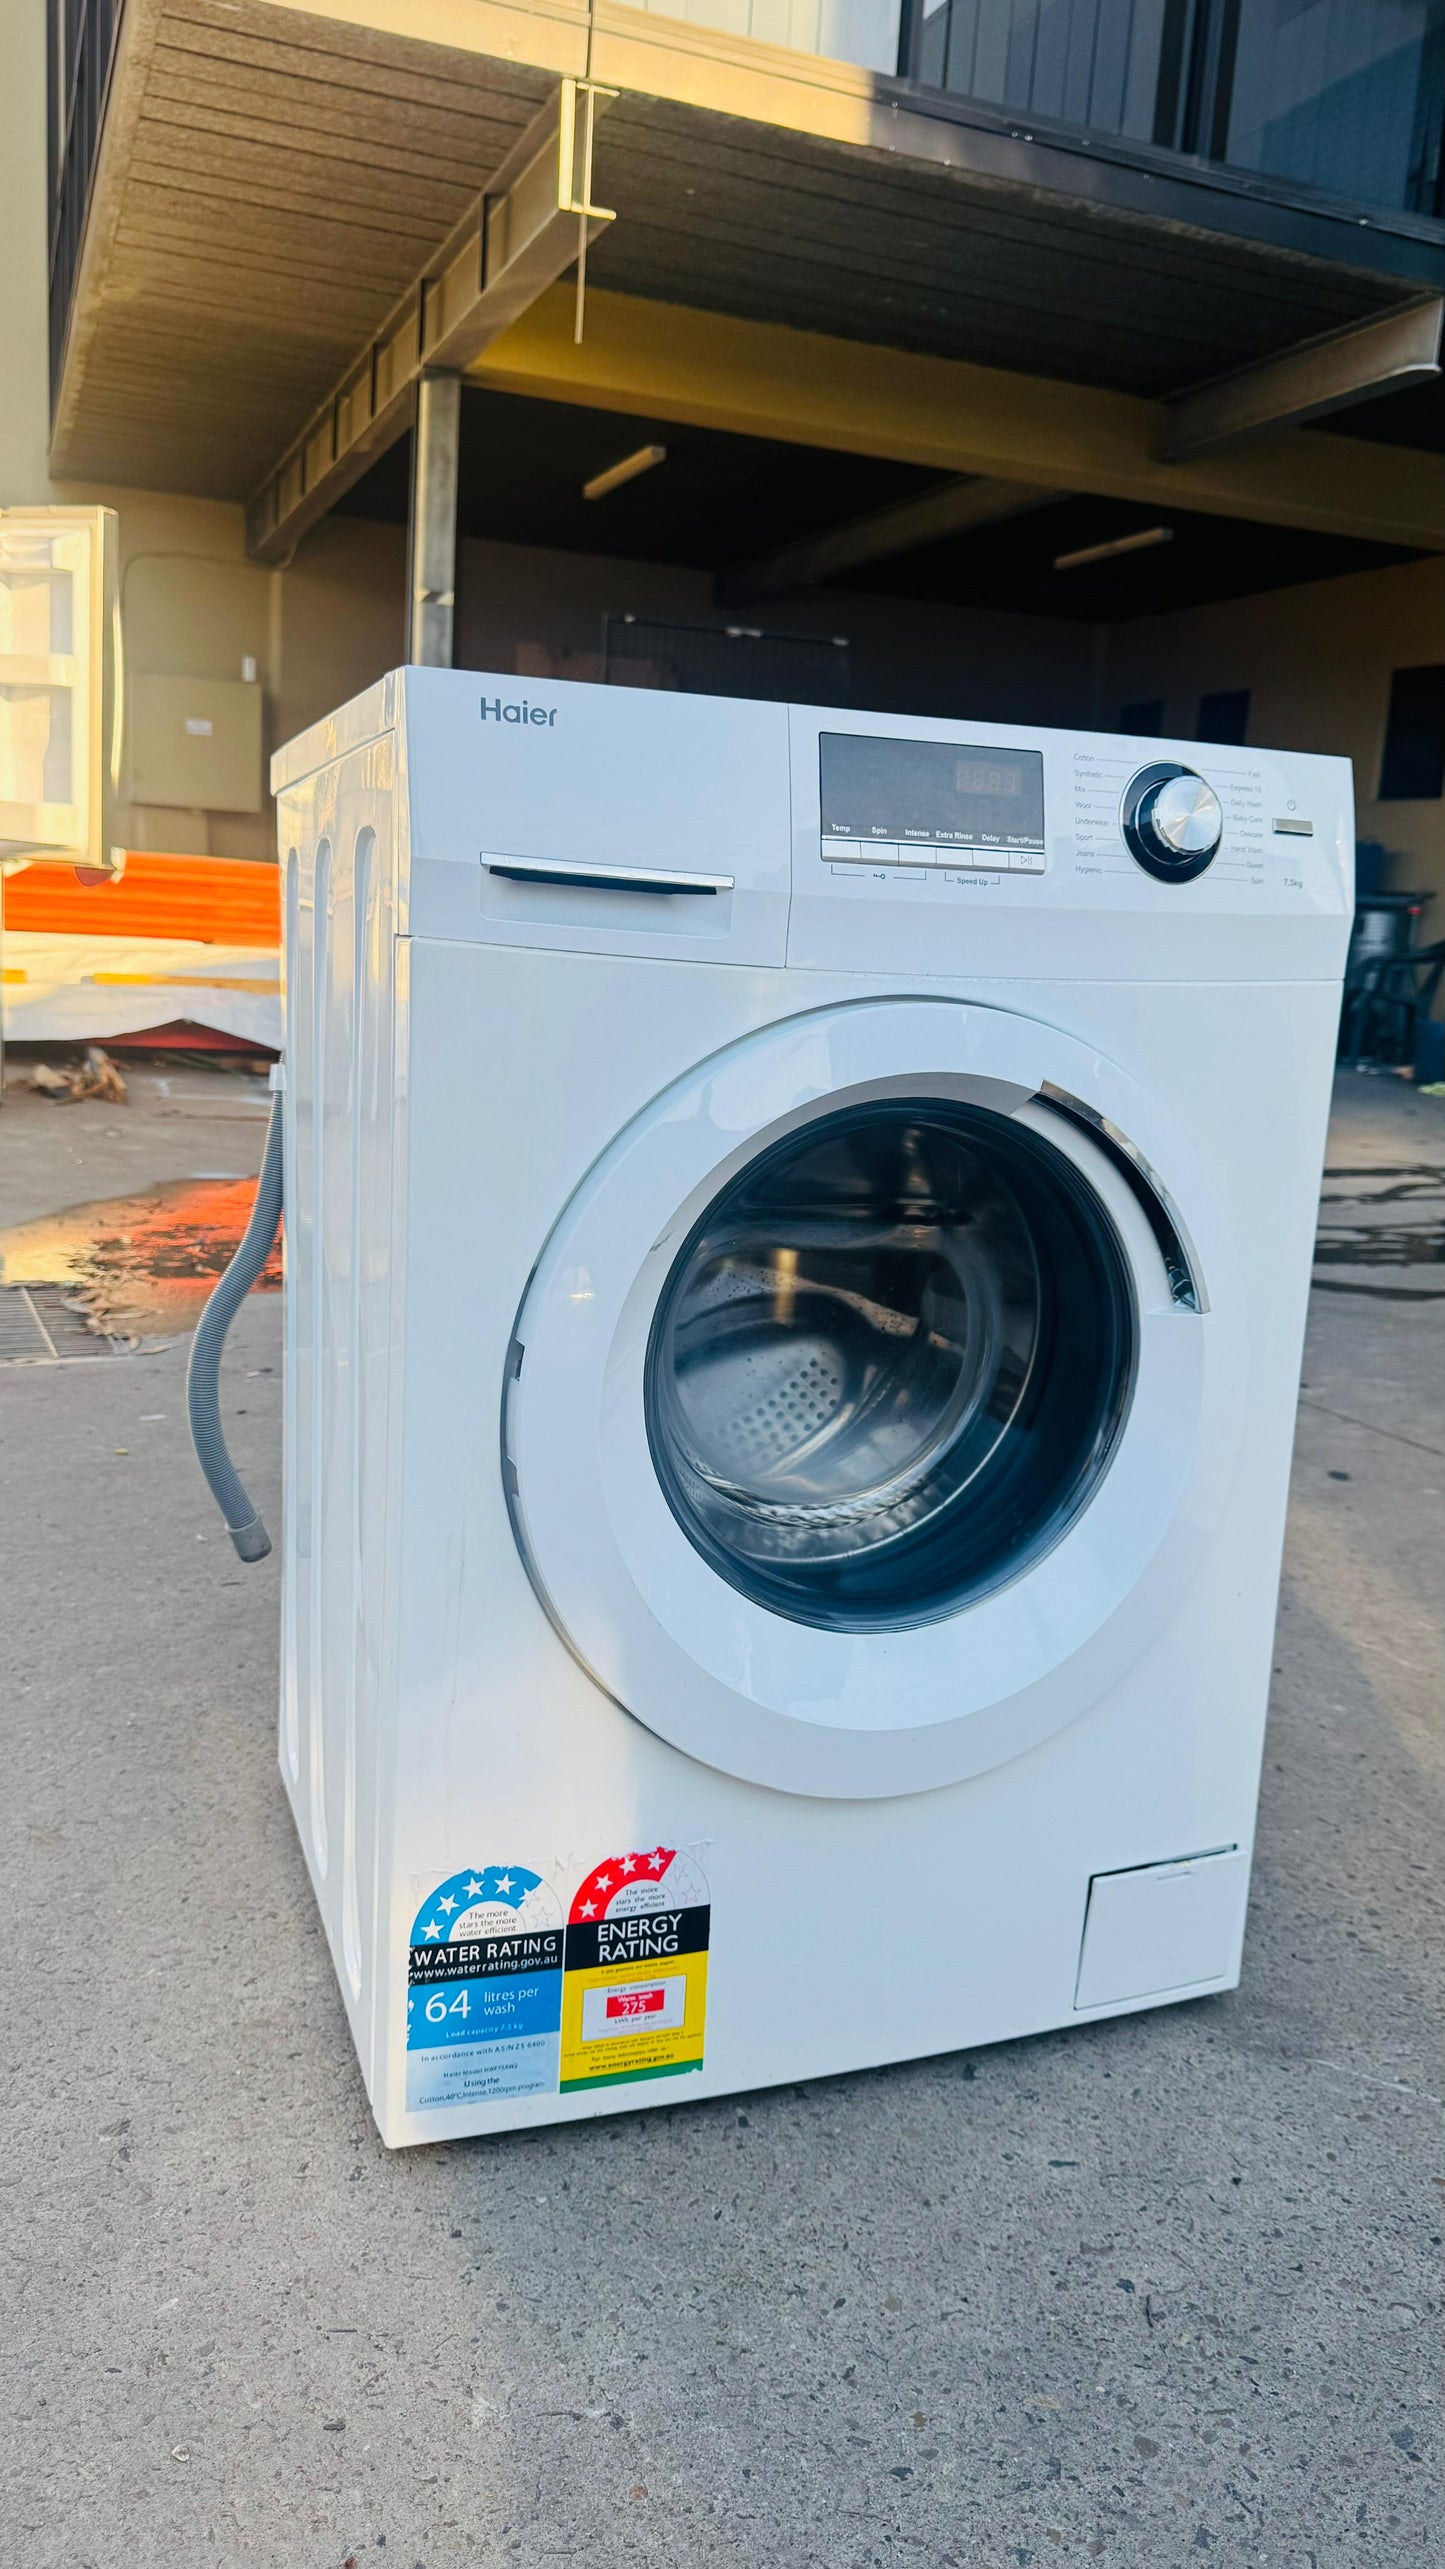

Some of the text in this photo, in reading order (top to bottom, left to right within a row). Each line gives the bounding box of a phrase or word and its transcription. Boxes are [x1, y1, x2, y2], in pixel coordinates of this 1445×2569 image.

[481, 697, 557, 727] Haier
[1073, 753, 1095, 761] Cotton
[1074, 769, 1103, 779] Synthetic
[1075, 801, 1091, 809] Wool
[1230, 799, 1245, 808] Daily
[1075, 817, 1109, 826] Underwear
[1233, 815, 1248, 823] Baby
[831, 823, 851, 834] Temp
[871, 826, 888, 836] Spin
[905, 828, 930, 838] Intense
[935, 830, 973, 841] Extra Rinse
[981, 833, 1001, 844] Delay
[1006, 835, 1044, 845] Start/Pause
[1075, 833, 1093, 842] Sport
[1075, 866, 1103, 875] Hygienic
[957, 877, 988, 887] Speed Up
[615, 1901, 665, 1913] energy efficient
[616, 1898, 631, 1906] stars
[469, 1910, 508, 1920] The more
[459, 1917, 517, 1930] stars the more
[597, 1913, 683, 1943] ENERGY
[459, 1925, 516, 1938] water efficient
[414, 1936, 556, 1967] WATER RATING
[599, 1935, 679, 1963] RATING
[413, 1954, 558, 1979] www.waterrating.gov.au
[484, 1987, 540, 2003] litres per
[424, 1989, 472, 2023] 64
[483, 2001, 516, 2016] wash
[622, 2000, 646, 2016] 275
[445, 2022, 524, 2039] Load capacity 7.5 kg
[430, 2050, 474, 2062] accordance
[476, 2047, 493, 2055] with
[464, 2079, 487, 2088] Using
